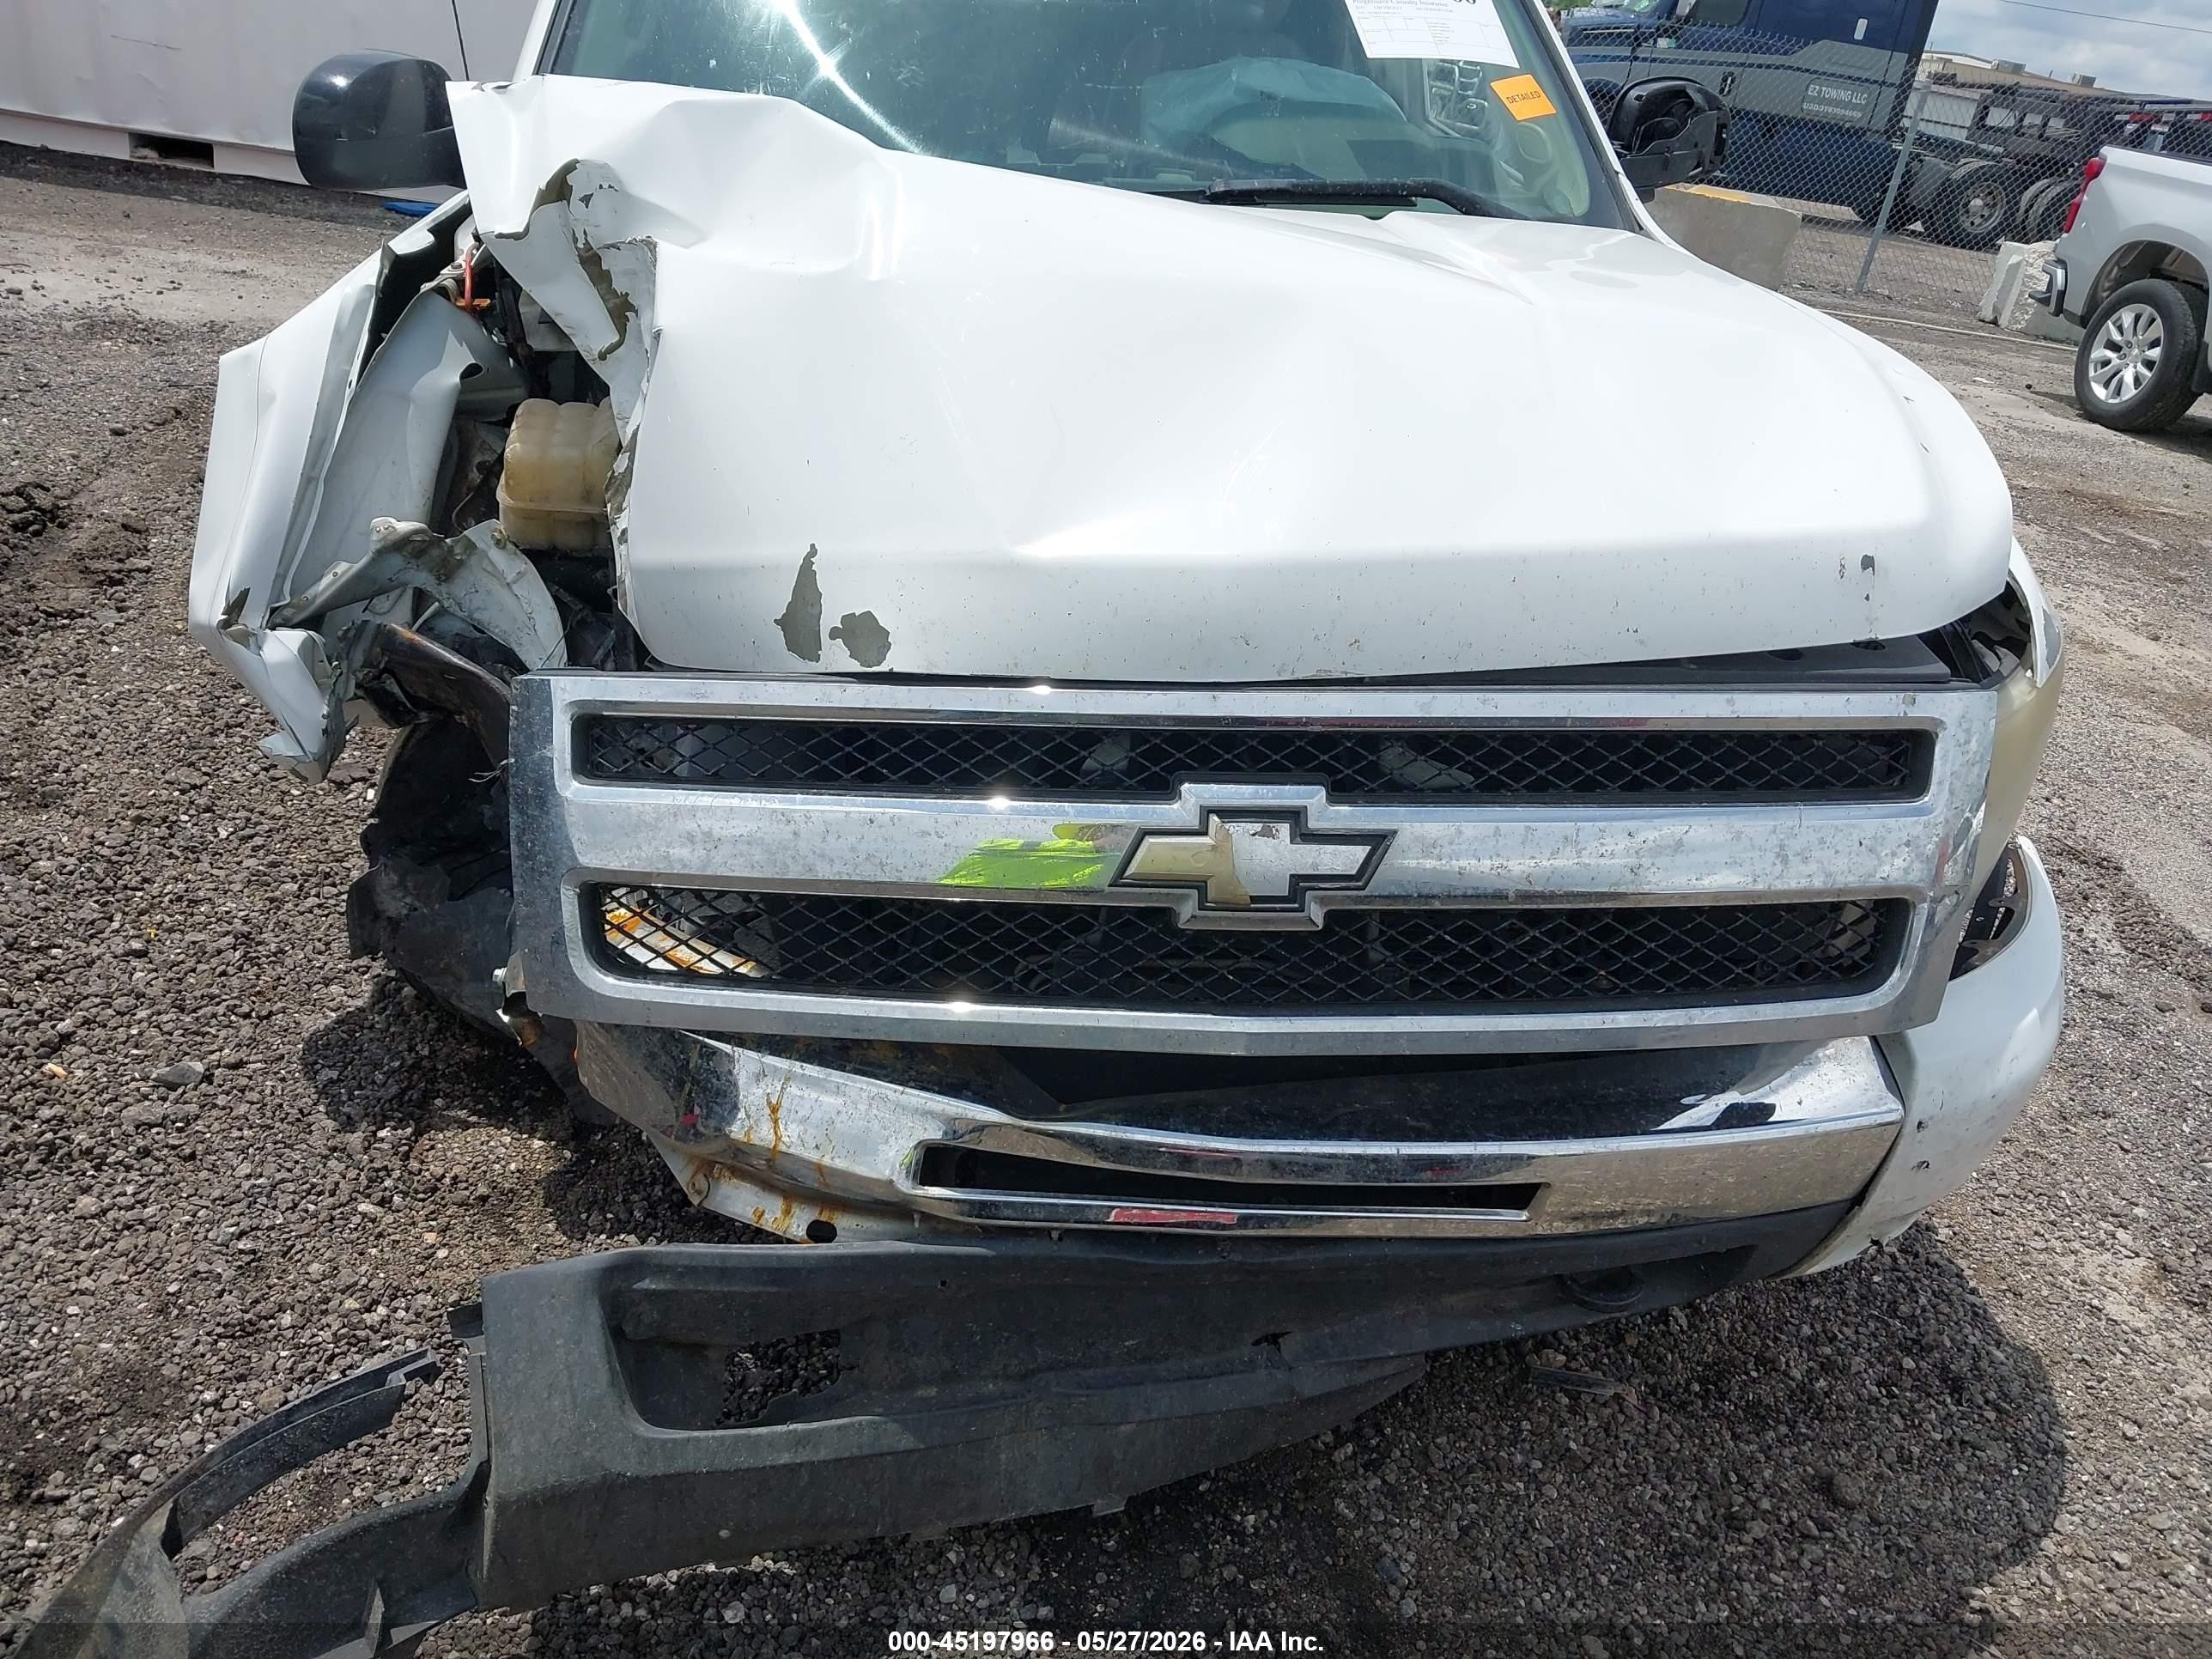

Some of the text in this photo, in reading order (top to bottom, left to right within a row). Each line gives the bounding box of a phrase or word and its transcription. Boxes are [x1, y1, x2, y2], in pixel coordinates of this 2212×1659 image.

[1506, 90, 1541, 104] DETAILED
[1808, 84, 1868, 105] EZ TOWING LLC
